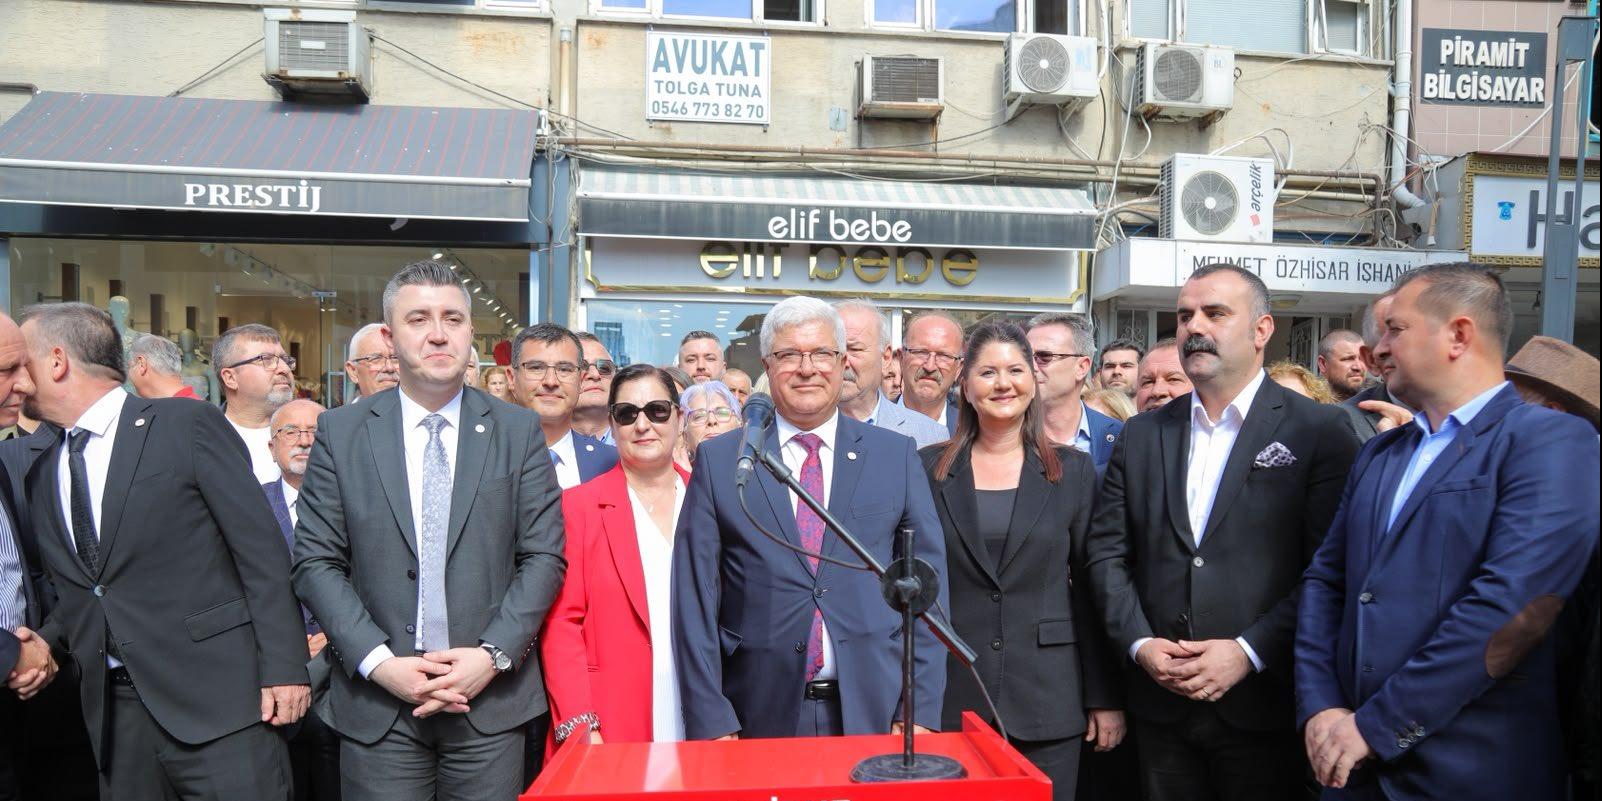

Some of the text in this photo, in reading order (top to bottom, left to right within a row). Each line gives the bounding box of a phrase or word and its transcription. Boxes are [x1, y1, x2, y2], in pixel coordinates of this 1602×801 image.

[652, 38, 765, 77] AVUKAT
[1440, 35, 1530, 68] PİRAMİT
[654, 80, 762, 98] TOLGA TUNA
[1423, 69, 1545, 103] BİLGİSAYAR
[652, 100, 764, 119] 0546 773 82 70
[184, 179, 322, 213] PRESTİJ
[1249, 160, 1264, 212] arçelik
[768, 208, 912, 242] elif bebe
[1276, 255, 1349, 281] ÖZHİSAR
